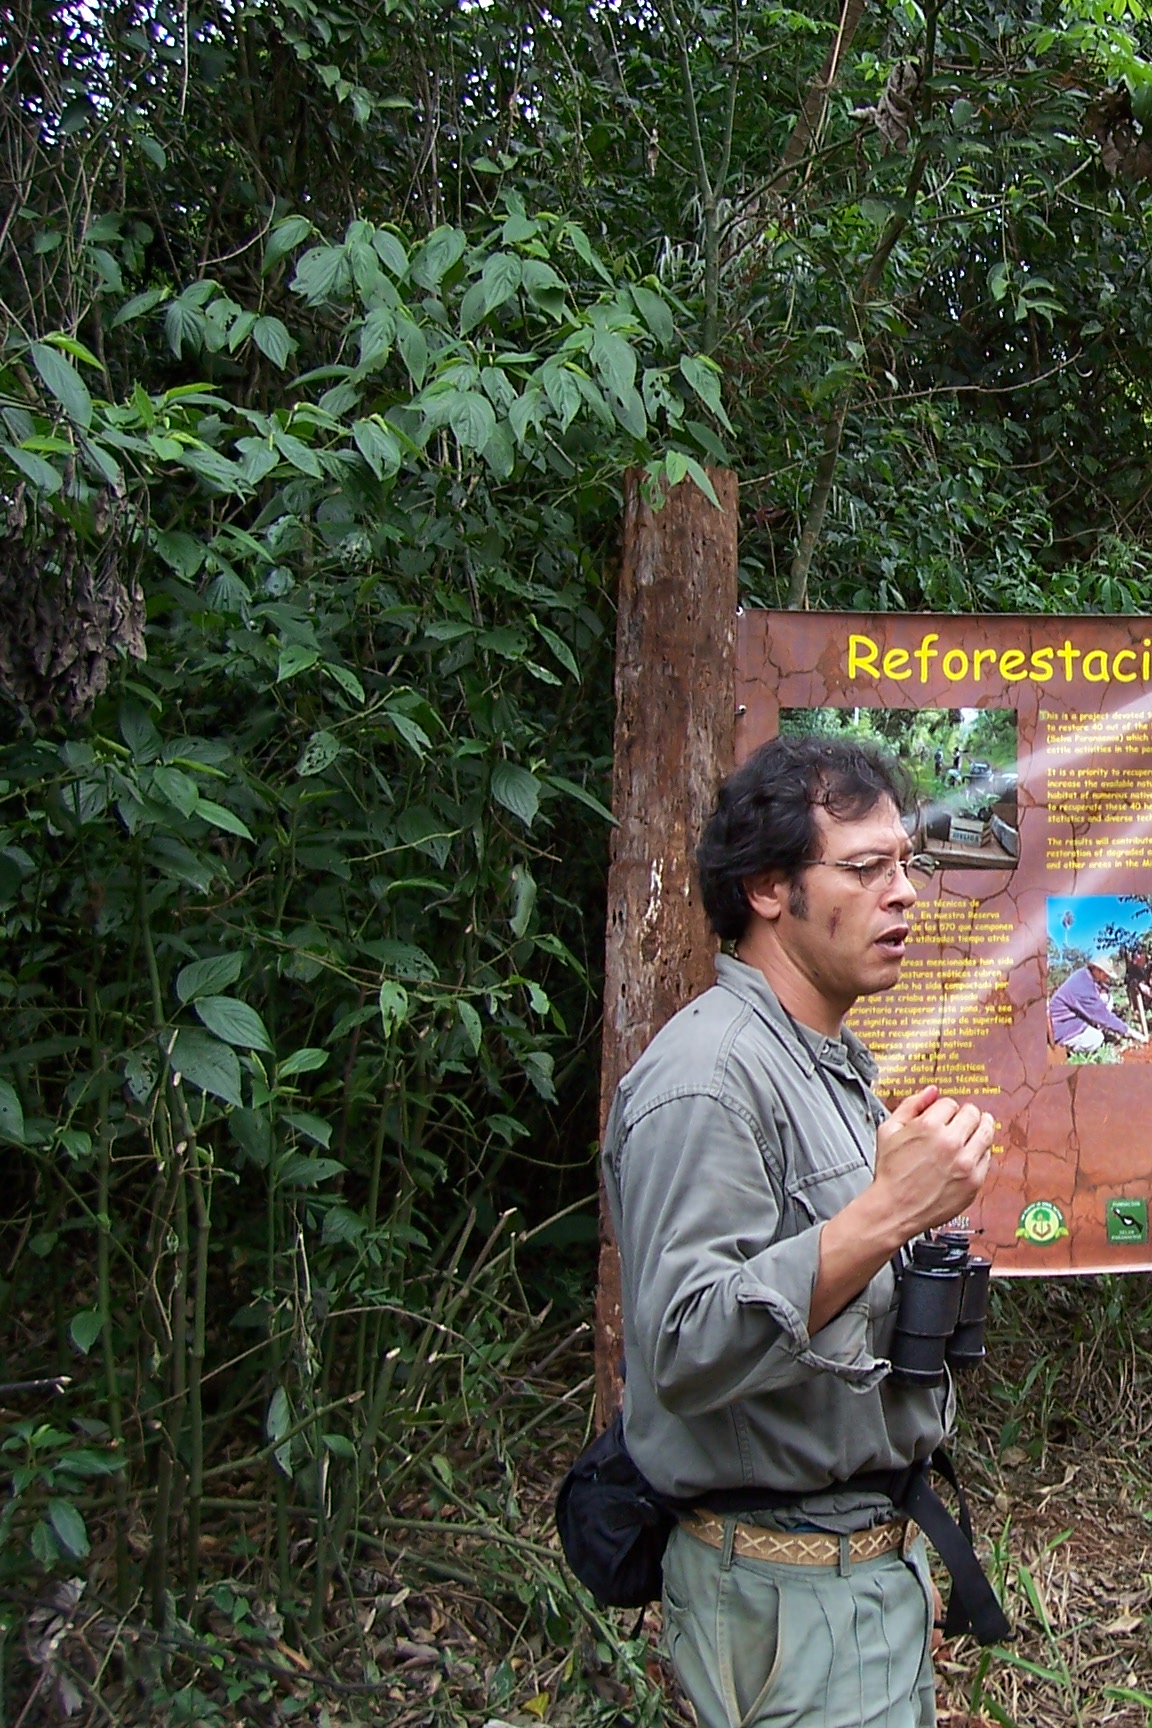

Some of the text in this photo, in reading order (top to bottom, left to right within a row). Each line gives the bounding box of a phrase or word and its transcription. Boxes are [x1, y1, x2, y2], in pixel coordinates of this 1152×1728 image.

[1080, 711, 1108, 722] project
[1112, 710, 1144, 720] devoted
[1047, 723, 1056, 731] to
[1058, 724, 1089, 732] restore
[1092, 722, 1103, 731] 40
[1105, 722, 1119, 731] out
[1122, 722, 1131, 731] of
[1134, 722, 1148, 731] the
[1126, 733, 1149, 742] which
[1047, 745, 1071, 754] cattle
[1074, 745, 1112, 753] activities
[1125, 745, 1139, 753] the
[1047, 768, 1056, 777] It
[1078, 768, 1109, 778] priority
[1047, 780, 1081, 788] increase
[1084, 780, 1098, 788] the
[1101, 779, 1134, 788] available
[1047, 790, 1077, 799] habitat
[1080, 790, 1089, 799] of
[1047, 803, 1056, 811] to
[1059, 803, 1102, 812] recuperate
[1105, 802, 1127, 811] these
[1130, 802, 1142, 811] 40
[1087, 813, 1102, 822] and
[1104, 813, 1133, 822] diverse
[1047, 838, 1062, 846] The
[1065, 837, 1092, 846] results
[1095, 837, 1109, 845] will
[1046, 849, 1092, 858] restoration
[1094, 849, 1103, 857] of
[1106, 848, 1145, 858] degraded
[1046, 861, 1061, 869] and
[1063, 861, 1086, 869] other
[1088, 861, 1112, 869] areas
[1125, 860, 1139, 868] the
[969, 899, 980, 908] de
[921, 910, 932, 919] En
[934, 911, 965, 919] nuestra
[911, 922, 921, 931] de
[925, 922, 936, 931] las
[958, 924, 972, 932] que
[975, 923, 1014, 932] componen
[959, 935, 985, 944] tiempo
[980, 957, 995, 966] han
[998, 956, 1014, 965] sido
[974, 969, 1002, 977] cubren
[911, 981, 922, 990] ha
[925, 980, 942, 990] sido
[995, 981, 1009, 991] por
[895, 1006, 936, 1015] recuperar
[985, 1005, 995, 1014] ya
[845, 1019, 860, 1027] que
[863, 1017, 898, 1028] significa
[900, 1016, 908, 1026] el
[959, 1015, 969, 1024] de
[943, 1028, 956, 1036] del
[906, 1040, 940, 1051] especies
[908, 1053, 926, 1061] este
[949, 1051, 959, 1060] de
[911, 1064, 934, 1073] datos
[903, 1075, 916, 1084] las
[919, 1075, 952, 1084] diversas
[893, 1087, 913, 1096] local
[982, 1085, 1001, 1094] nivel
